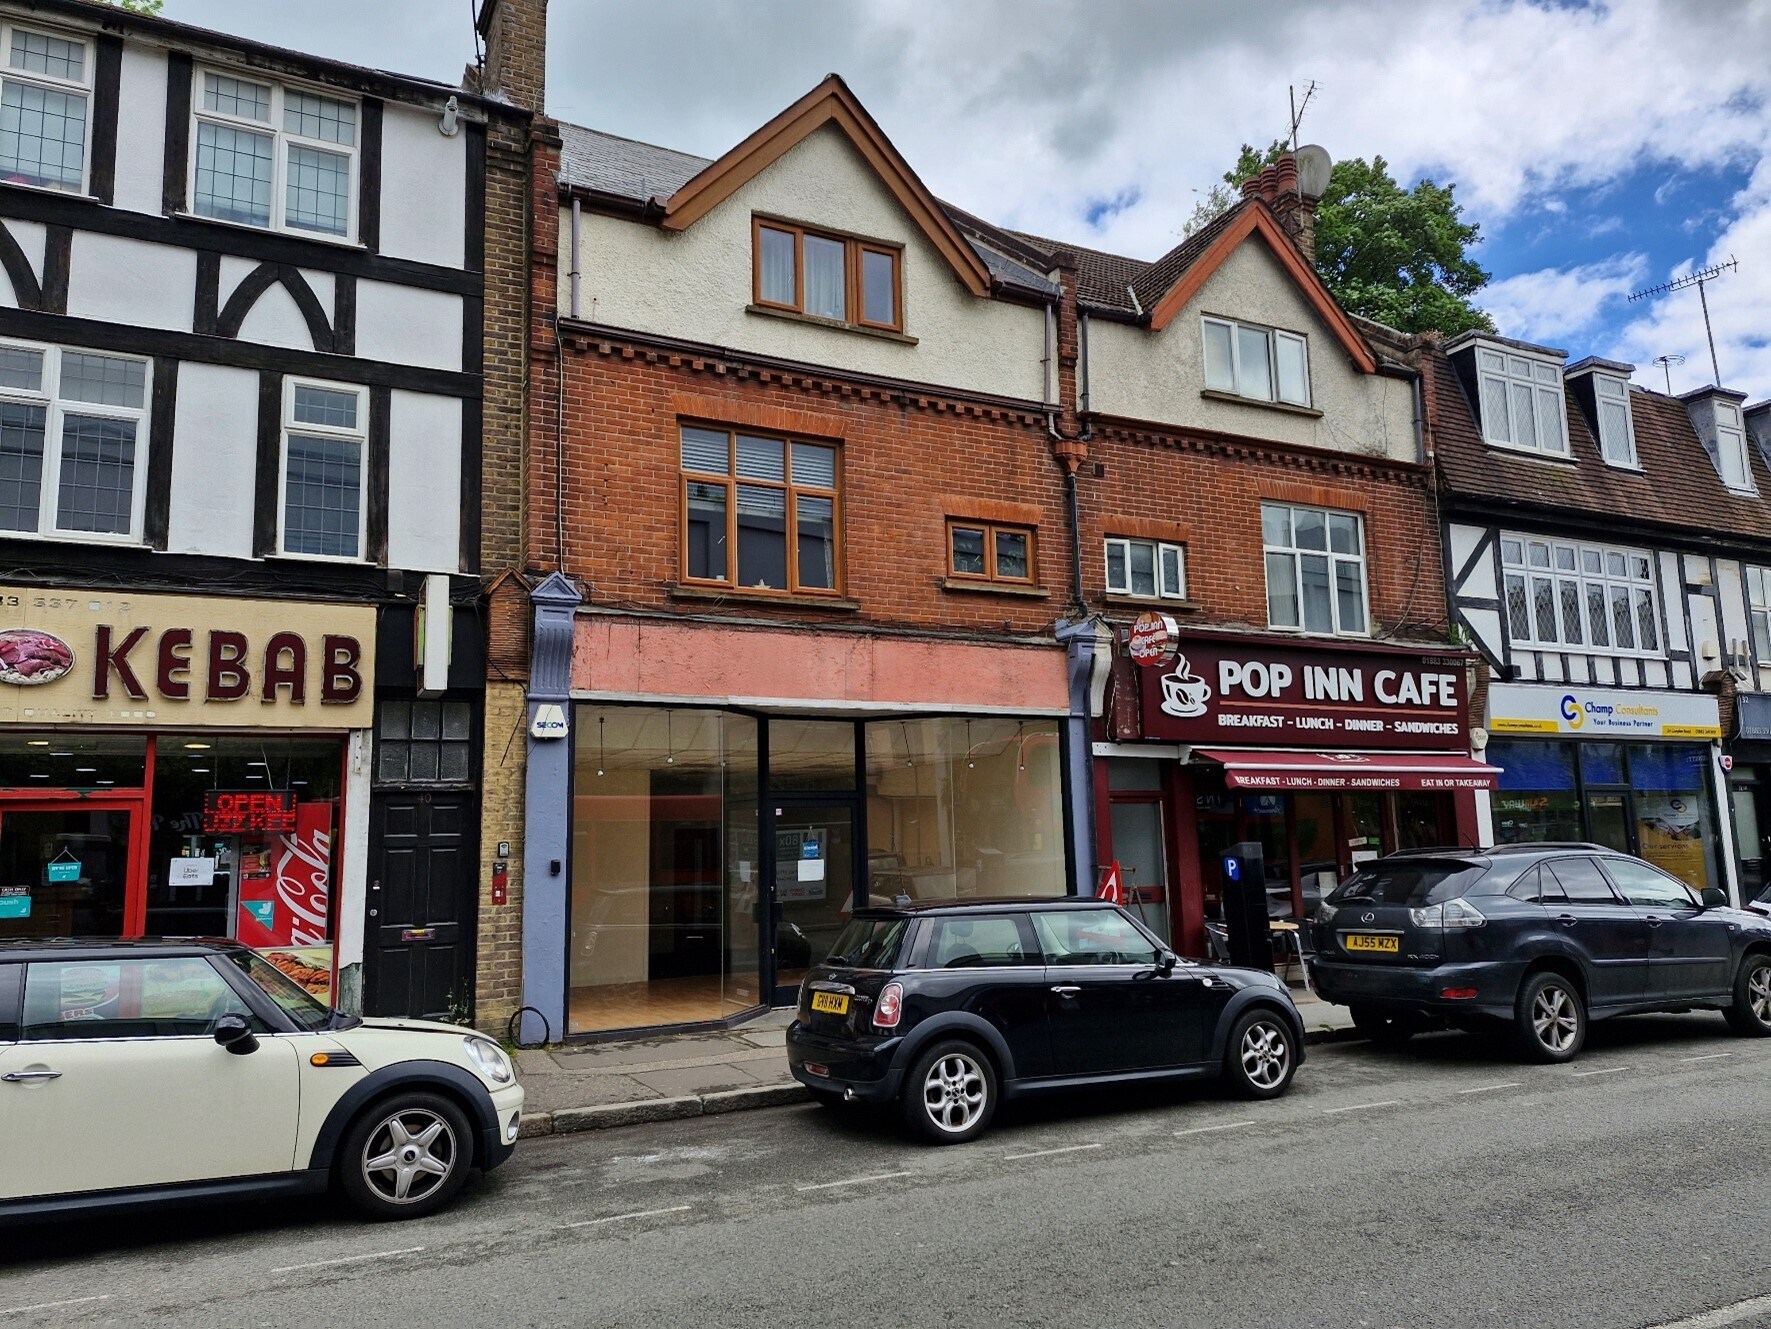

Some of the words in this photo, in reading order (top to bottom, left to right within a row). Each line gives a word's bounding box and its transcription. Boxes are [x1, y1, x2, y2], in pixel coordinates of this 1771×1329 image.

[1133, 623, 1150, 633] POP
[92, 623, 363, 706] KEBAB
[1421, 656, 1441, 665] 01883
[1218, 660, 1292, 698] POP
[1303, 665, 1364, 701] INN
[1374, 670, 1458, 706] CAFE
[1584, 701, 1613, 716] Champ
[1615, 703, 1659, 716] Consultants
[536, 721, 564, 729] SECOM
[1218, 714, 1284, 728] BREAKFAST
[1296, 717, 1334, 730] LUNCH
[1345, 719, 1384, 732] DINNER
[1394, 721, 1459, 735] SANDWICHES
[1593, 718, 1606, 726] Your
[1608, 719, 1631, 727] Business
[1234, 776, 1280, 786] BREAKFAST
[1286, 777, 1312, 786] LUNCH
[1317, 778, 1345, 787] DINNER
[1351, 778, 1400, 787] SANDWICHES
[1421, 778, 1435, 787] EAT
[1435, 778, 1443, 787] IN
[1444, 778, 1454, 787] OR
[1455, 778, 1490, 787] TAKEAWAY
[217, 794, 283, 812] OPEN
[1227, 859, 1237, 876] P
[1353, 936, 1376, 947] AJ55
[1378, 938, 1397, 949] MZX
